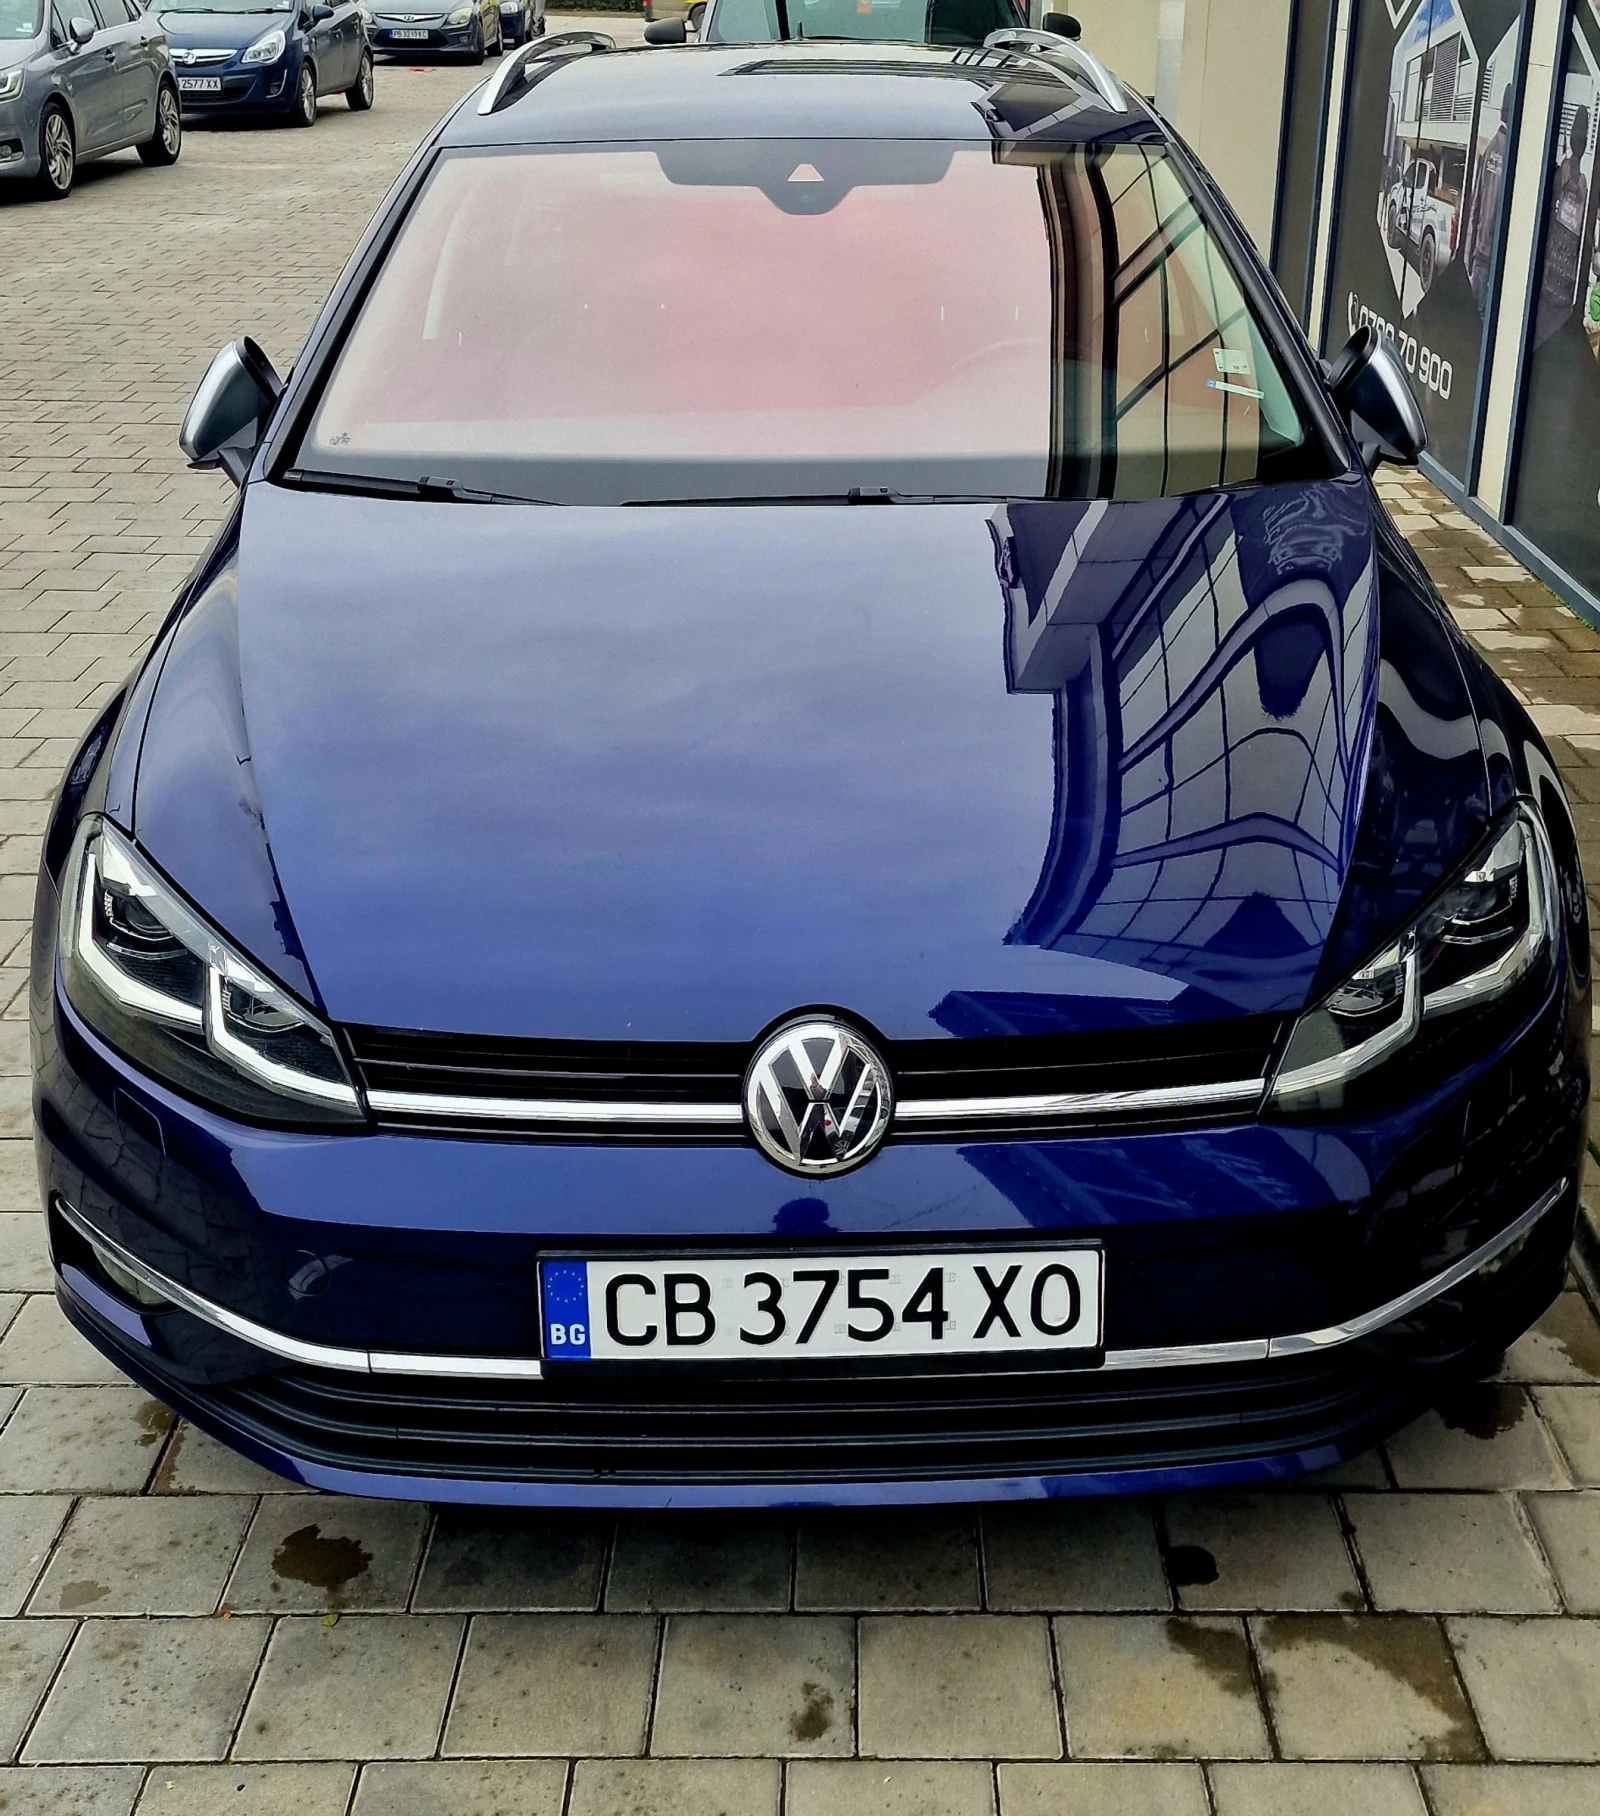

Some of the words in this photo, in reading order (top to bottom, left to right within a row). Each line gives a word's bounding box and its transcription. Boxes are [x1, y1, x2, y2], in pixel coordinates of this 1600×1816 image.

[181, 79, 204, 89] 2577
[206, 79, 219, 89] XX
[1399, 330, 1417, 374] 70
[1419, 346, 1453, 400] 900
[605, 1272, 717, 1347] CB
[739, 1266, 949, 1346] 3754
[972, 1263, 1081, 1339] XO
[550, 1323, 586, 1346] BG
